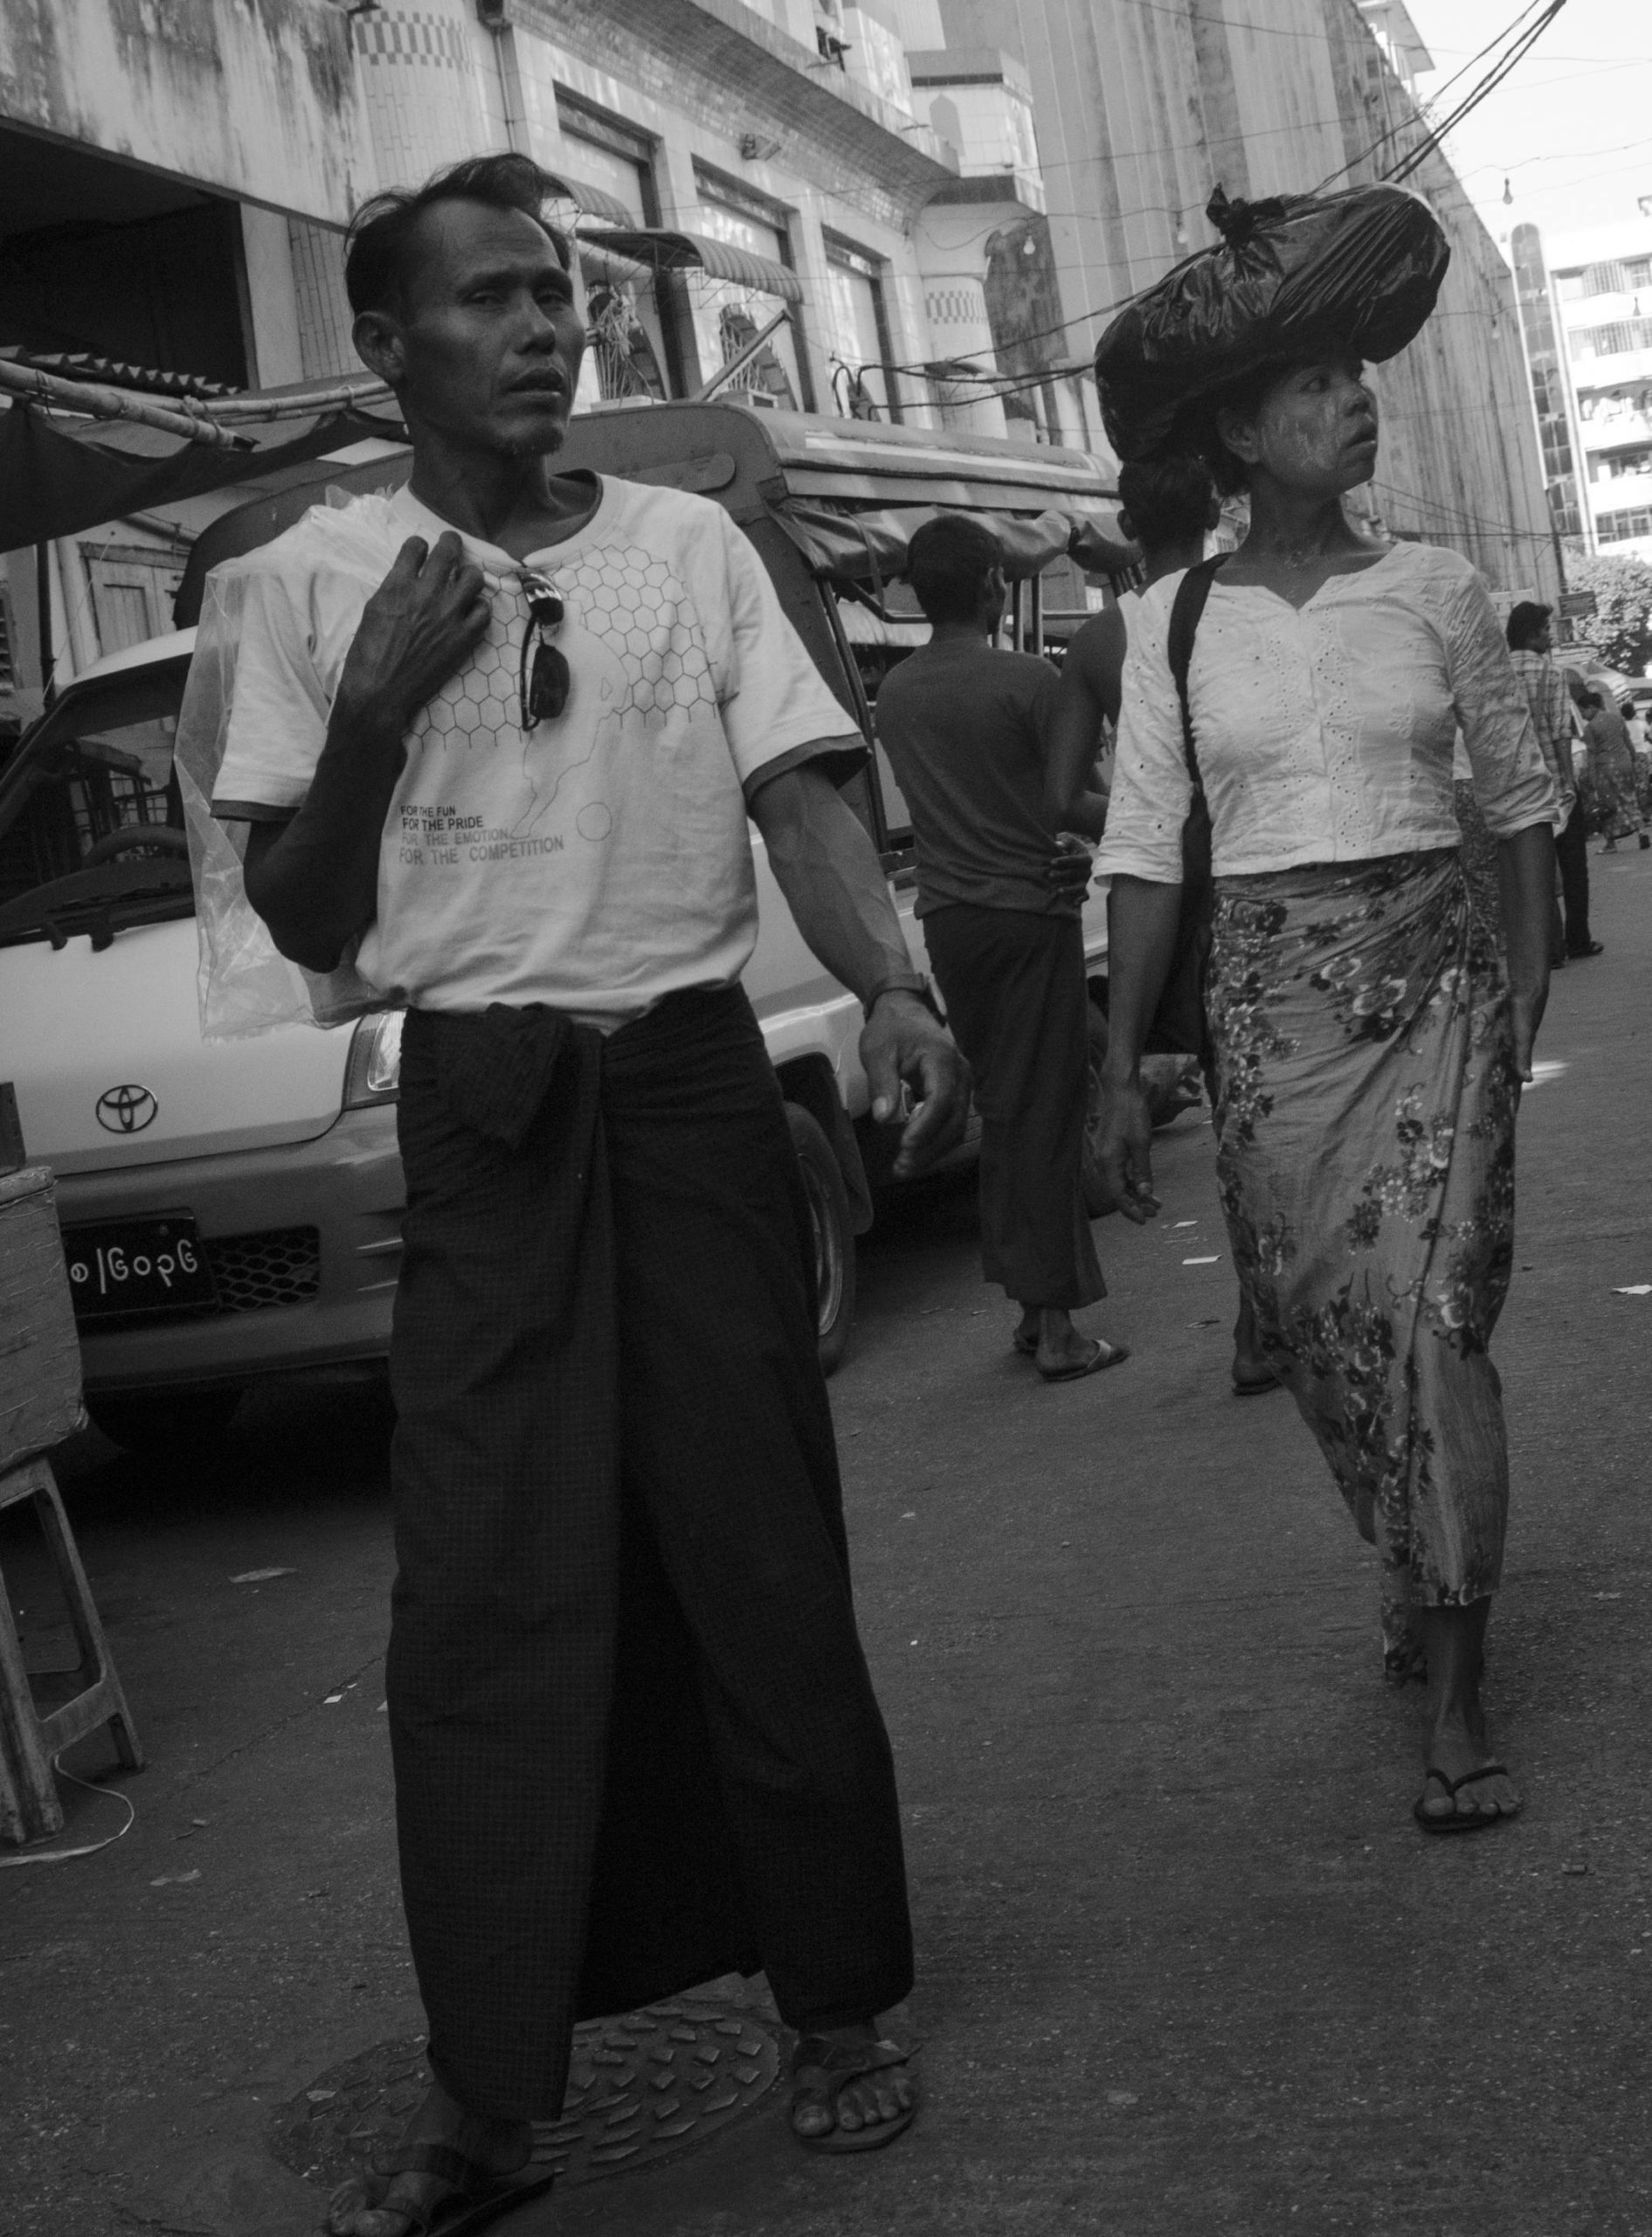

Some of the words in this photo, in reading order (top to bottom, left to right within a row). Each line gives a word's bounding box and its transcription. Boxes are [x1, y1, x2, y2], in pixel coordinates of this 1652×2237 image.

[400, 806, 418, 816] FOR
[419, 807, 434, 818] THE
[437, 805, 456, 817] FUN
[403, 817, 419, 830] FOR
[421, 819, 445, 832] THE
[448, 815, 484, 830] PRIDE
[401, 831, 418, 845] FOR
[425, 833, 448, 847] THE
[454, 828, 509, 845] EMOTION
[398, 846, 425, 866] FOR
[431, 847, 460, 866] THE
[468, 835, 565, 862] COMPETITION
